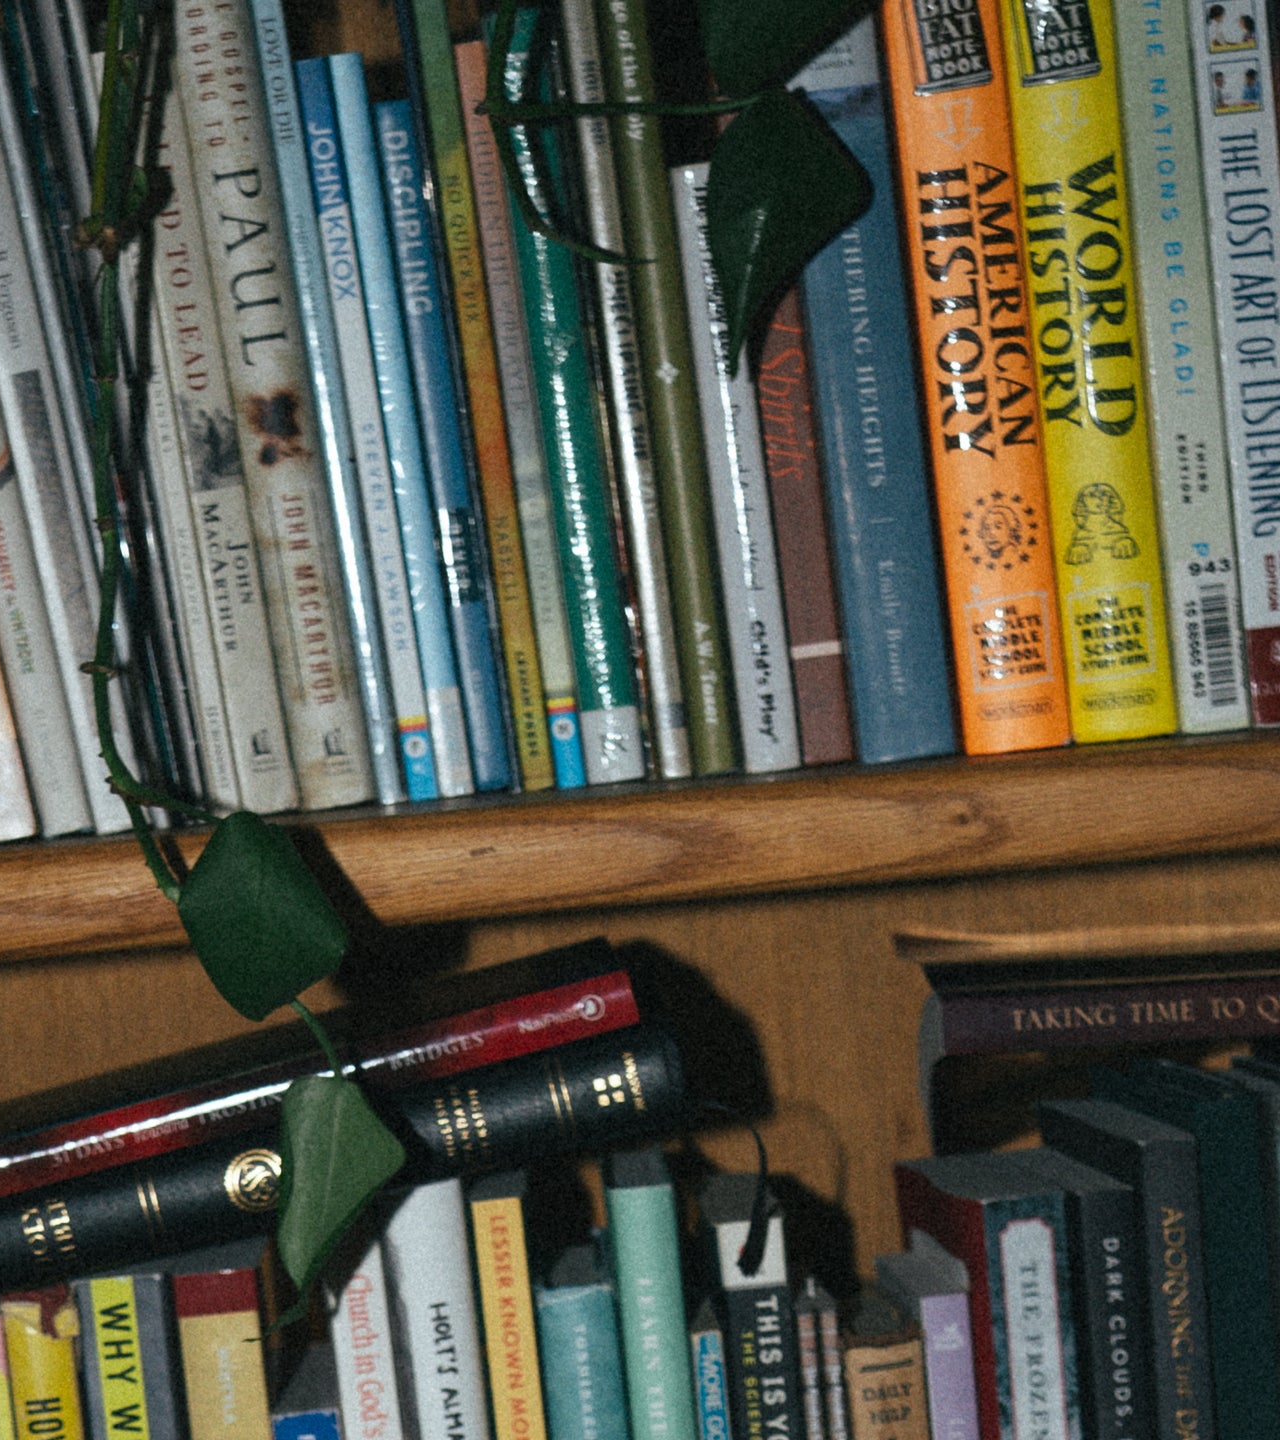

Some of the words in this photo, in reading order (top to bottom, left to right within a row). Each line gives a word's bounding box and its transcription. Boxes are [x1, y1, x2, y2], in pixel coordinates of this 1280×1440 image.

[922, 12, 976, 45] FAT
[1141, 0, 1166, 58] THE
[305, 120, 342, 206] JOHN
[1148, 76, 1180, 222] NATIONS
[1218, 126, 1263, 181] THE
[321, 214, 358, 301] KNOX
[379, 128, 431, 317] DISCIPLING
[1223, 187, 1274, 265] LOST
[163, 242, 193, 291] TO
[209, 163, 294, 367] PAUL
[1065, 150, 1139, 439] WORLD
[1162, 241, 1185, 279] BE
[910, 164, 1003, 465] HISTORY
[967, 158, 1041, 448] AMERICAN
[1023, 178, 1083, 431] HISTORY
[1230, 269, 1280, 328] ART
[173, 302, 209, 393] LEAD
[1166, 296, 1194, 398] GLAD!
[1236, 335, 1278, 370] OF
[1174, 433, 1192, 506] EDITION
[1193, 440, 1209, 494] THIRD
[280, 491, 312, 552] JOHN
[226, 537, 260, 606] JOHN
[1262, 552, 1280, 612] EDITION
[291, 564, 337, 708] MACARTHUR
[1011, 1001, 1117, 1032] TAKING
[1130, 998, 1195, 1025] TIME
[1210, 995, 1247, 1022] TO
[487, 1213, 515, 1289] LESSER
[1101, 1236, 1126, 1303] DARK
[97, 1301, 138, 1386] WHY
[342, 1272, 378, 1350] Church
[496, 1296, 526, 1391] KNOWN
[753, 1295, 783, 1366] THIS
[353, 1351, 381, 1375] in
[760, 1376, 786, 1405] IS
[1105, 1314, 1135, 1427] CLOUDS,
[356, 1377, 390, 1438] God's
